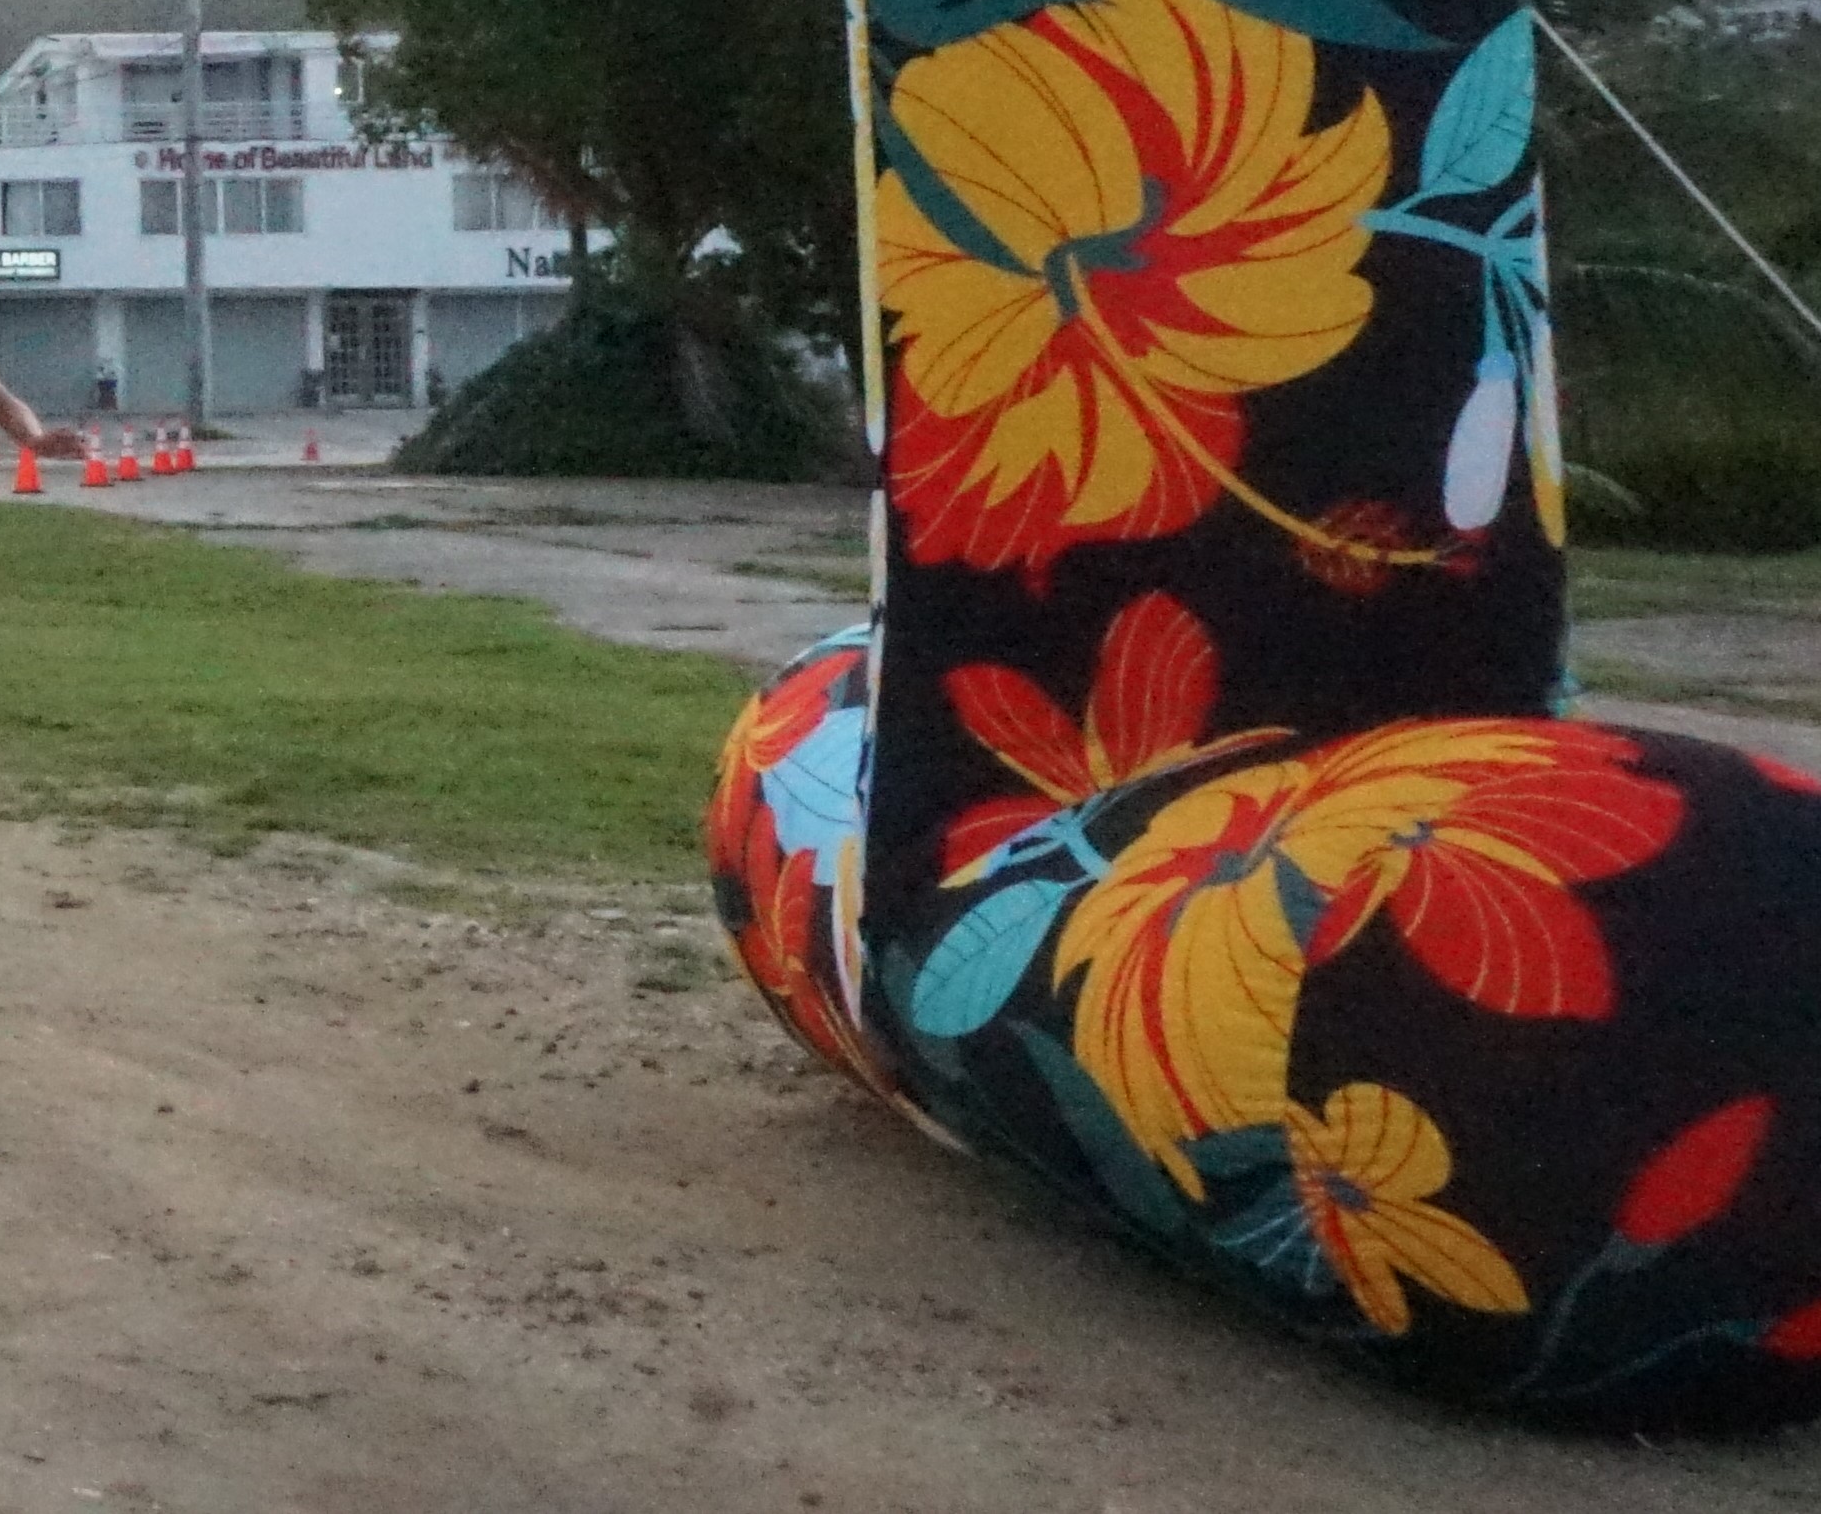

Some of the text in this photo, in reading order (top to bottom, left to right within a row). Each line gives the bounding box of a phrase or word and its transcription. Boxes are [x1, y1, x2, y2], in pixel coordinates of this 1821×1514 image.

[233, 145, 259, 170] of
[261, 144, 368, 170] Beautiful
[1, 251, 57, 267] BARBER
